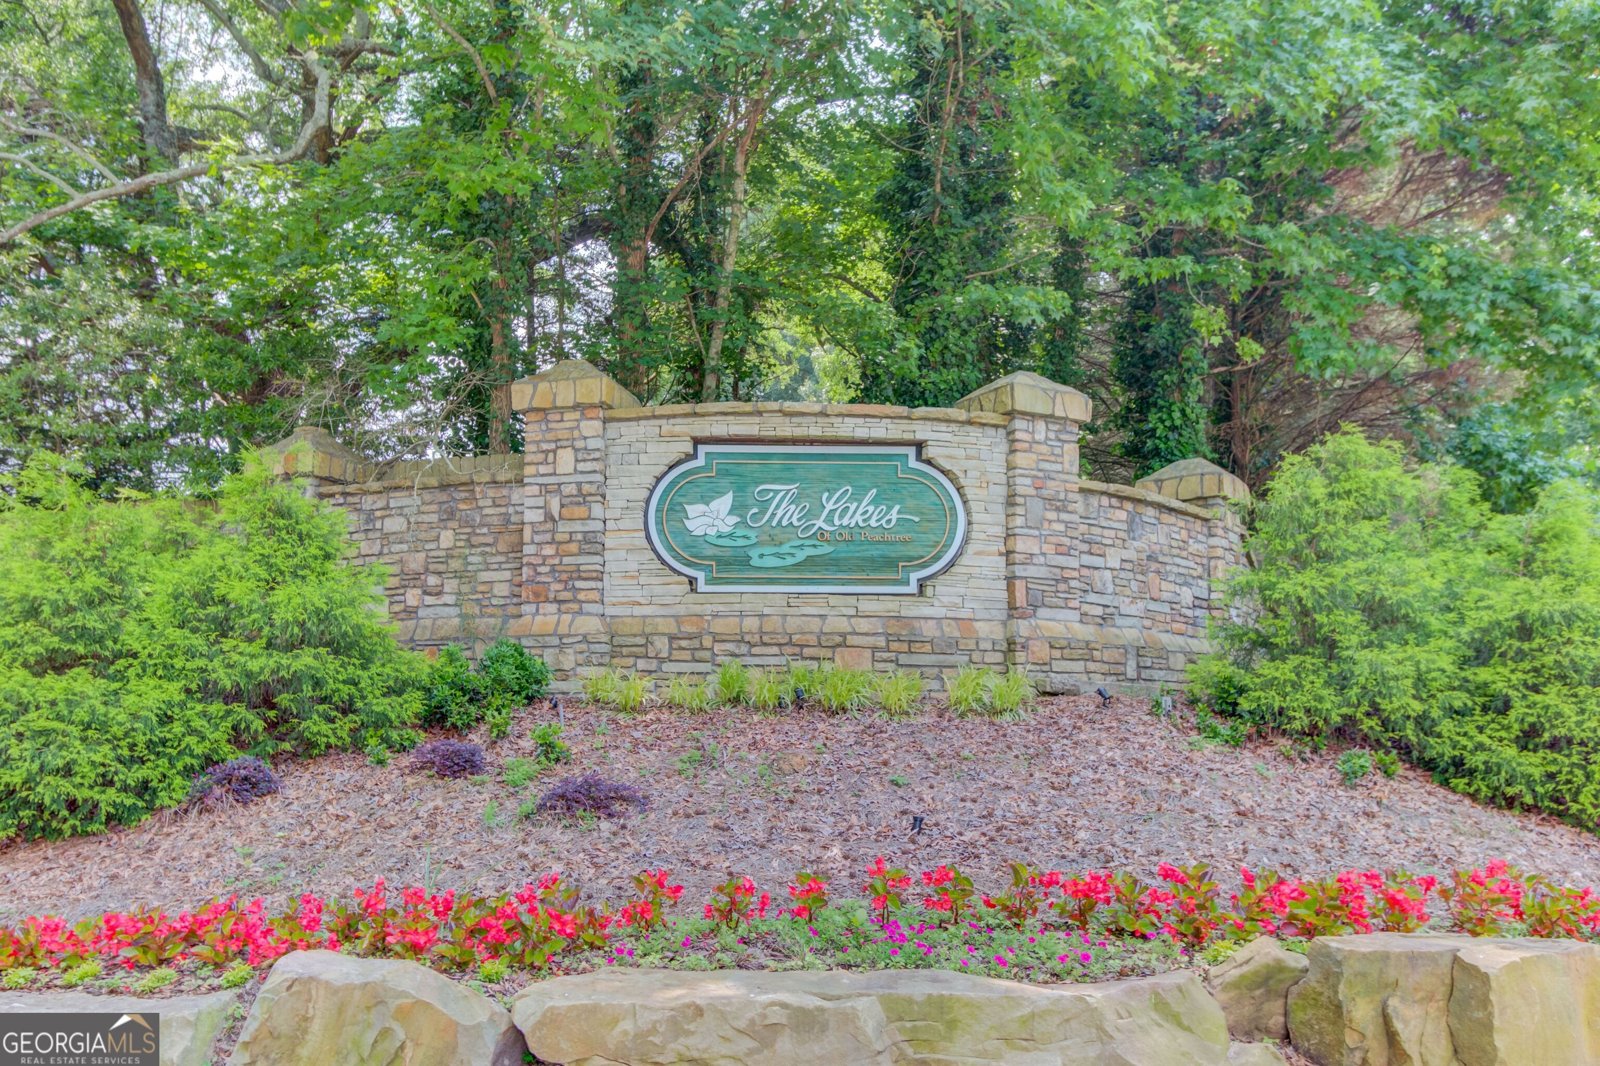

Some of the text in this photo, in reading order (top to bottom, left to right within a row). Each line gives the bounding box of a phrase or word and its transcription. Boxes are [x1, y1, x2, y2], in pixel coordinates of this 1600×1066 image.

[747, 483, 920, 538] The Lakes
[861, 531, 912, 542] Peachtree
